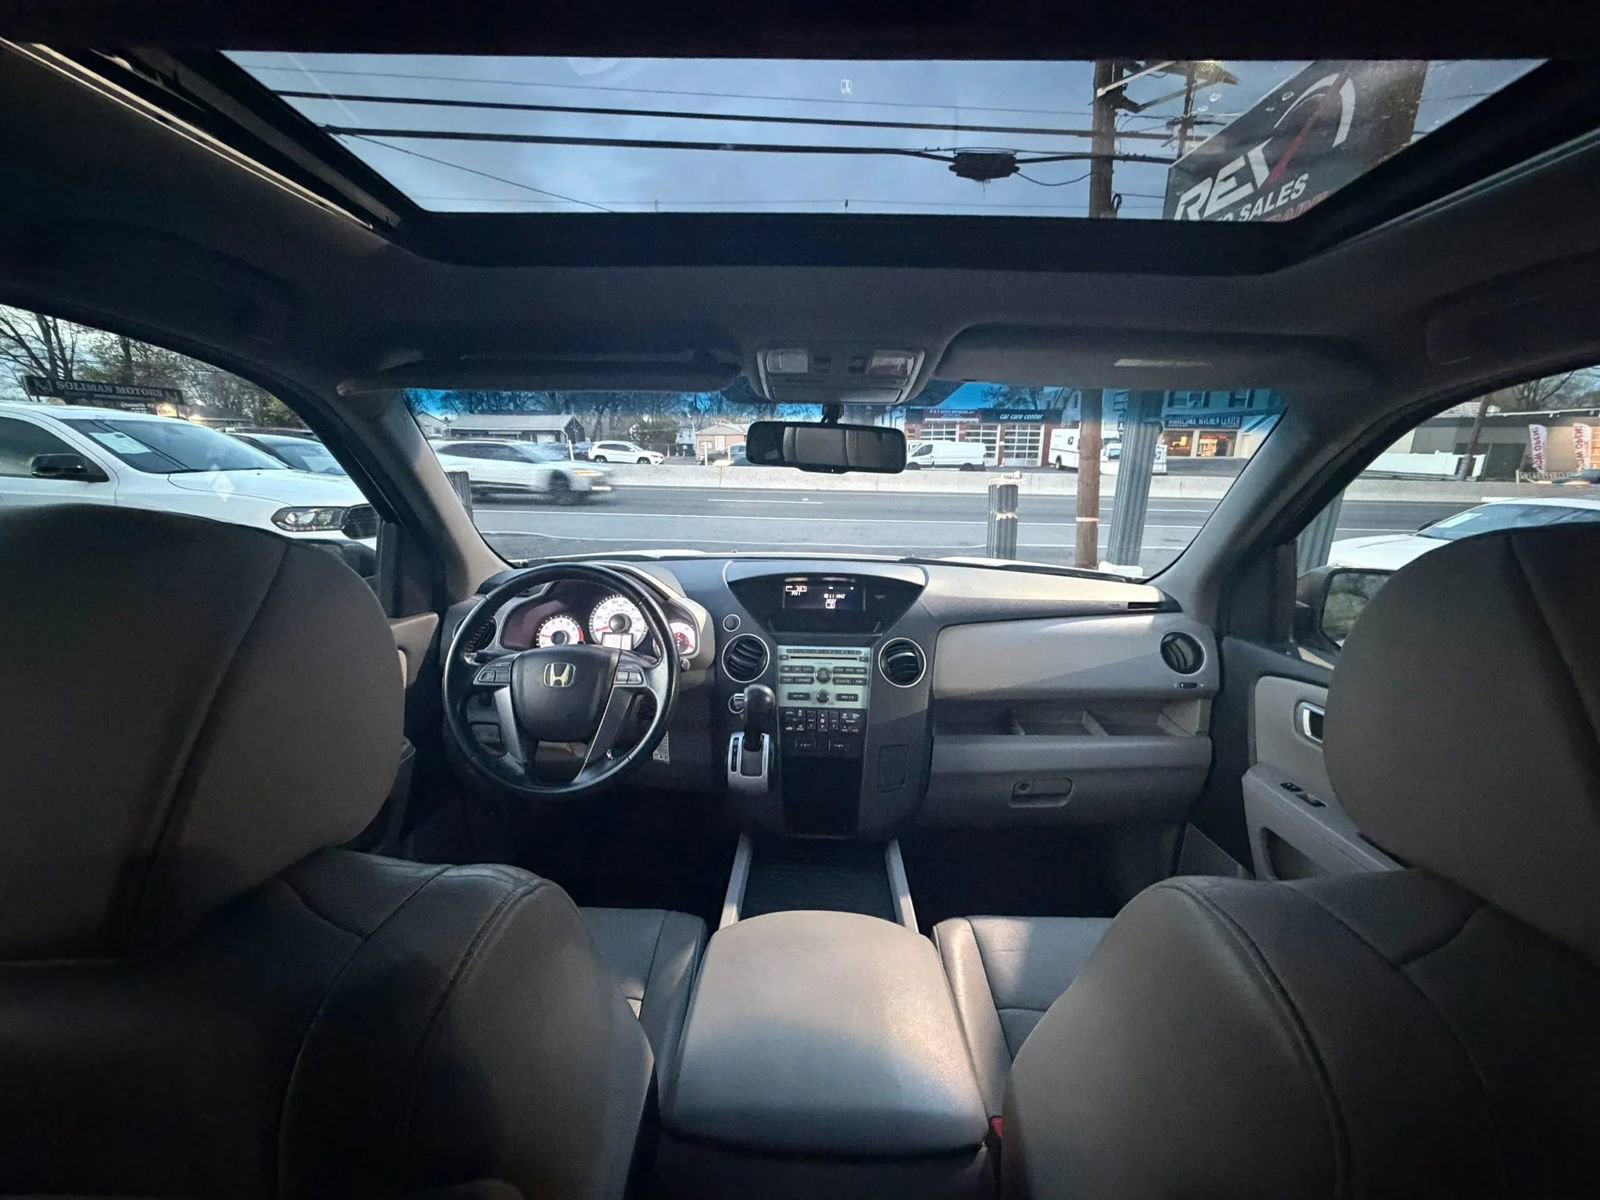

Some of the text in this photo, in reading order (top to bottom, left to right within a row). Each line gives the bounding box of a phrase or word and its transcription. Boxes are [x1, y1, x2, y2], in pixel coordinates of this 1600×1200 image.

[1239, 172, 1309, 221] SALES
[56, 381, 163, 397] SOLIMAN MOTORS
